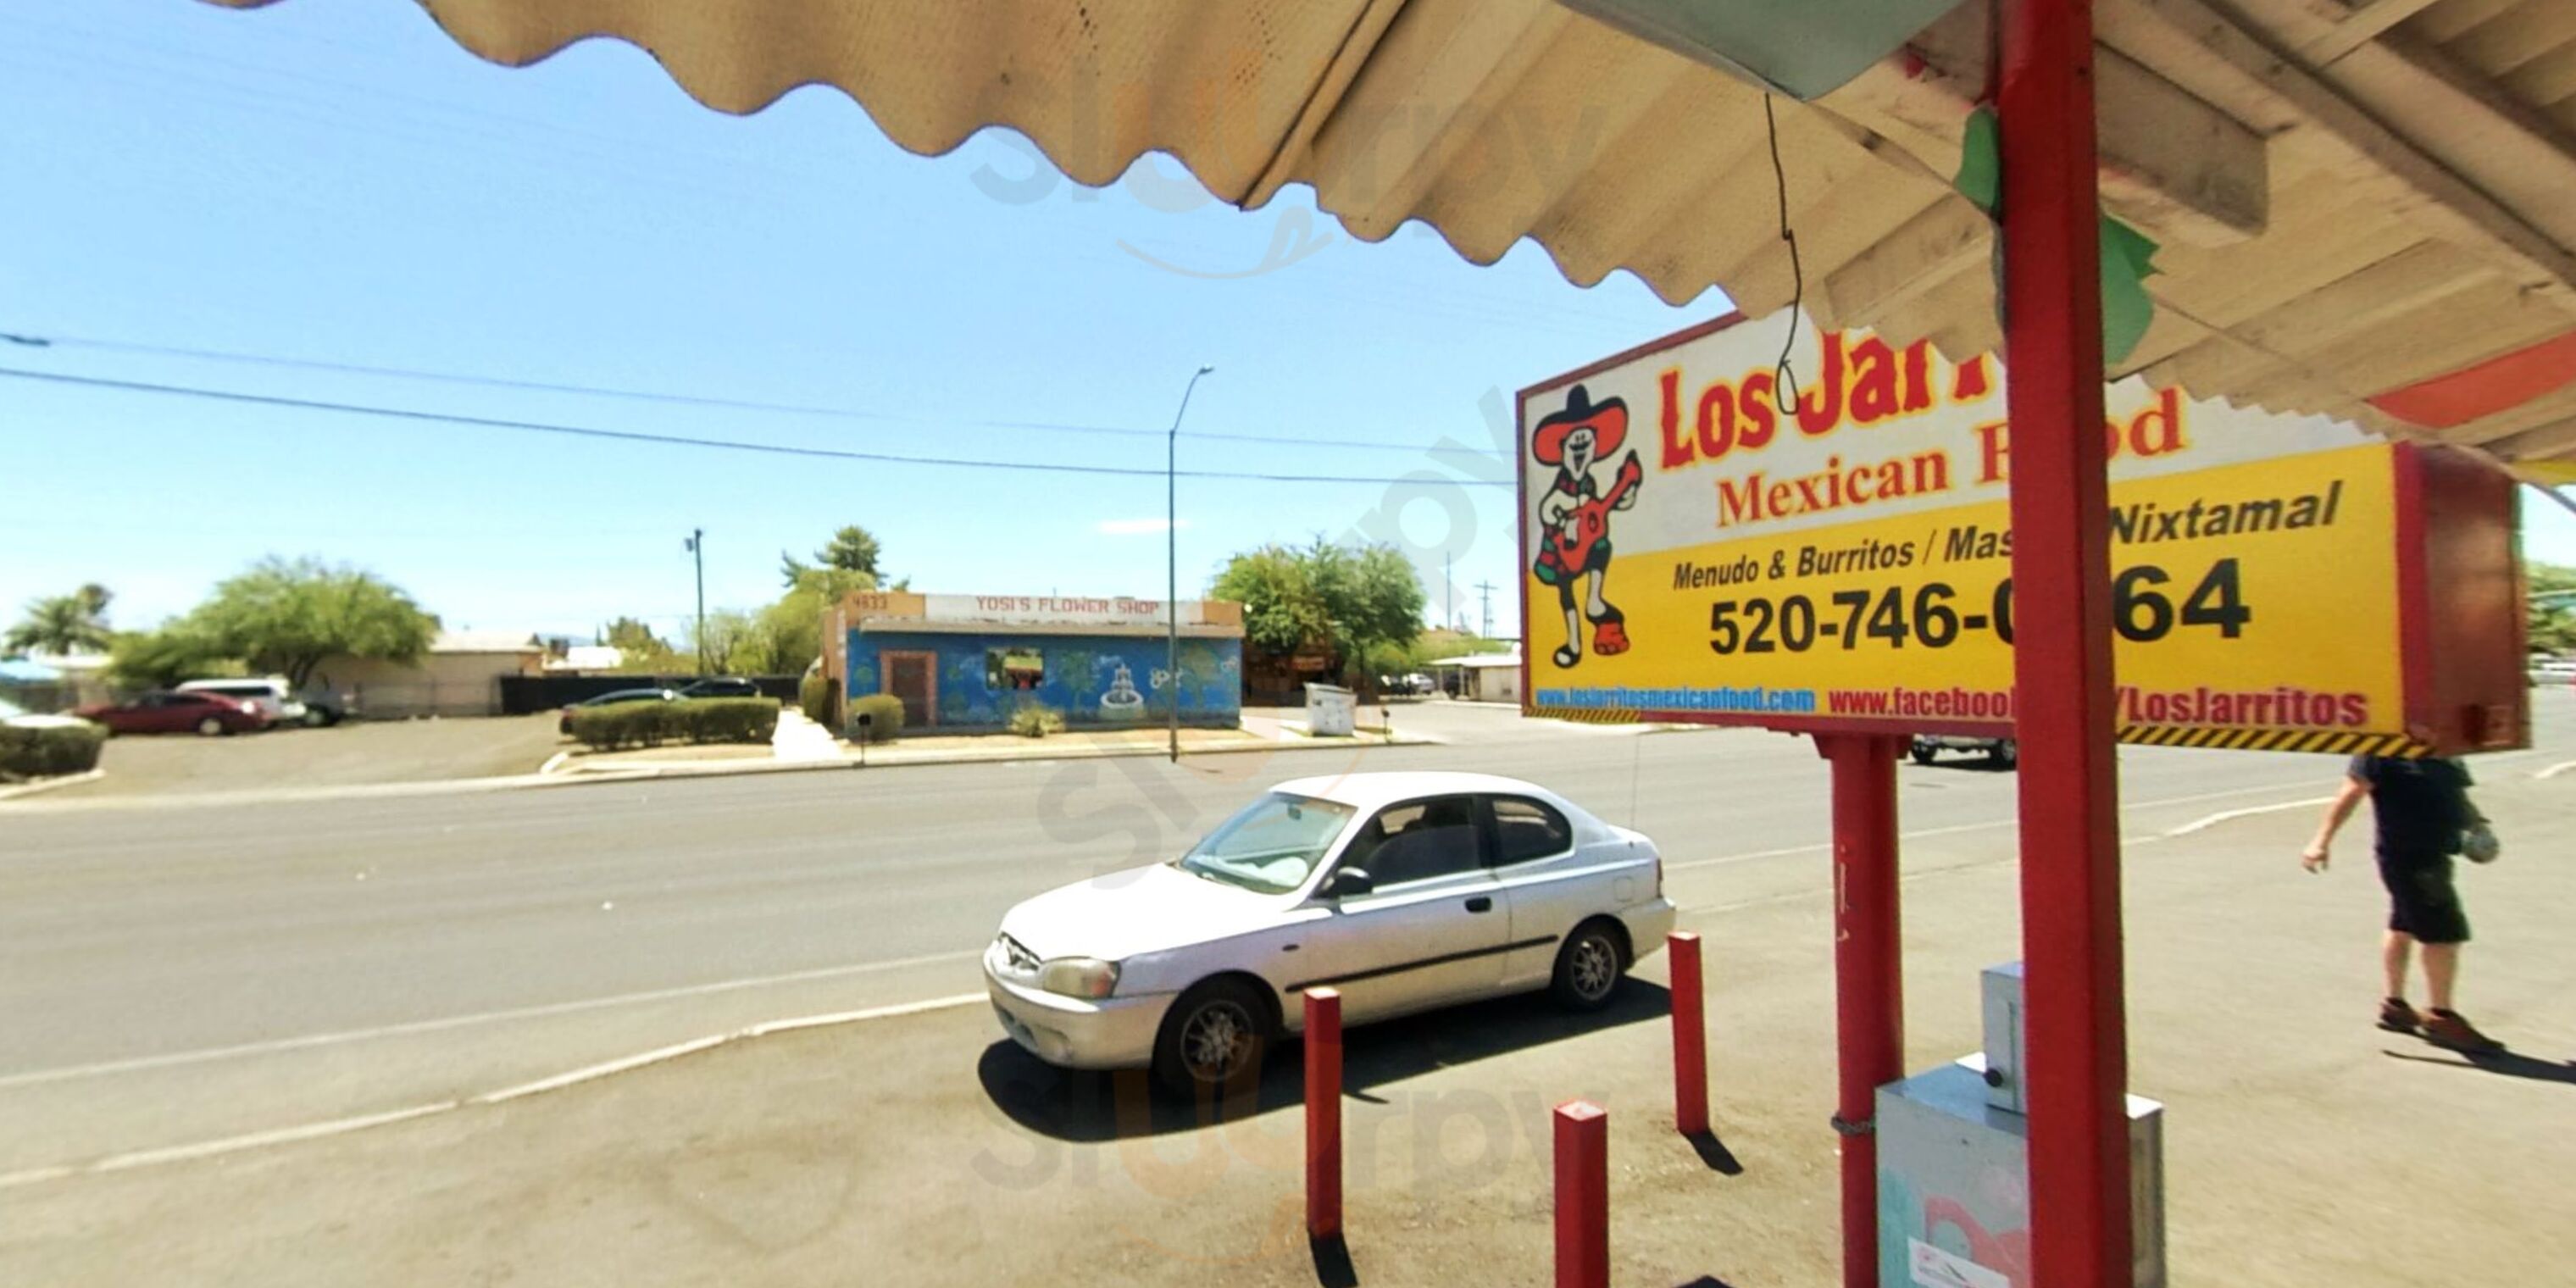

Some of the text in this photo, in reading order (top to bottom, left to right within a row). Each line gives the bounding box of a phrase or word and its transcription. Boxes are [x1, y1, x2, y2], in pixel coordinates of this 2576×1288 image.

[1658, 369, 1776, 470] Los
[1673, 480, 2344, 591] Menudo & Burritos / Mas Nixtamal
[1716, 455, 1949, 529] Mexican
[1038, 597, 1109, 613] FLOWER
[1116, 600, 1160, 615] SHOP
